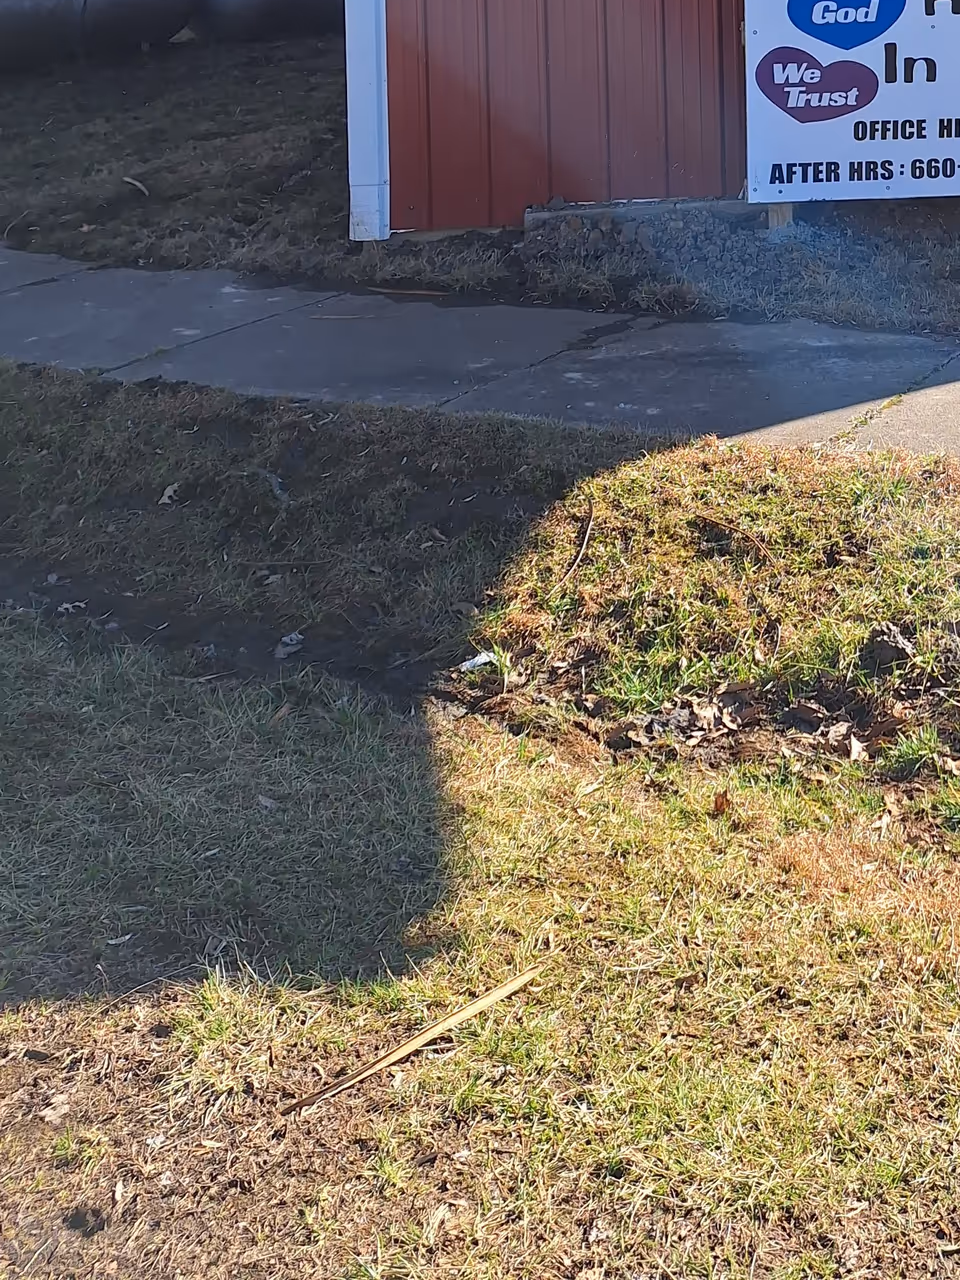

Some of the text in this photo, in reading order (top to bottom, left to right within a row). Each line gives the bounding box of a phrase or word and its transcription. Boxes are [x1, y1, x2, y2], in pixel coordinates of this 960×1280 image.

[812, 0, 880, 24] God
[772, 62, 822, 85] We
[884, 42, 937, 83] In
[784, 87, 859, 108] Trust
[853, 120, 927, 141] OFFICE
[769, 161, 840, 185] AFTER
